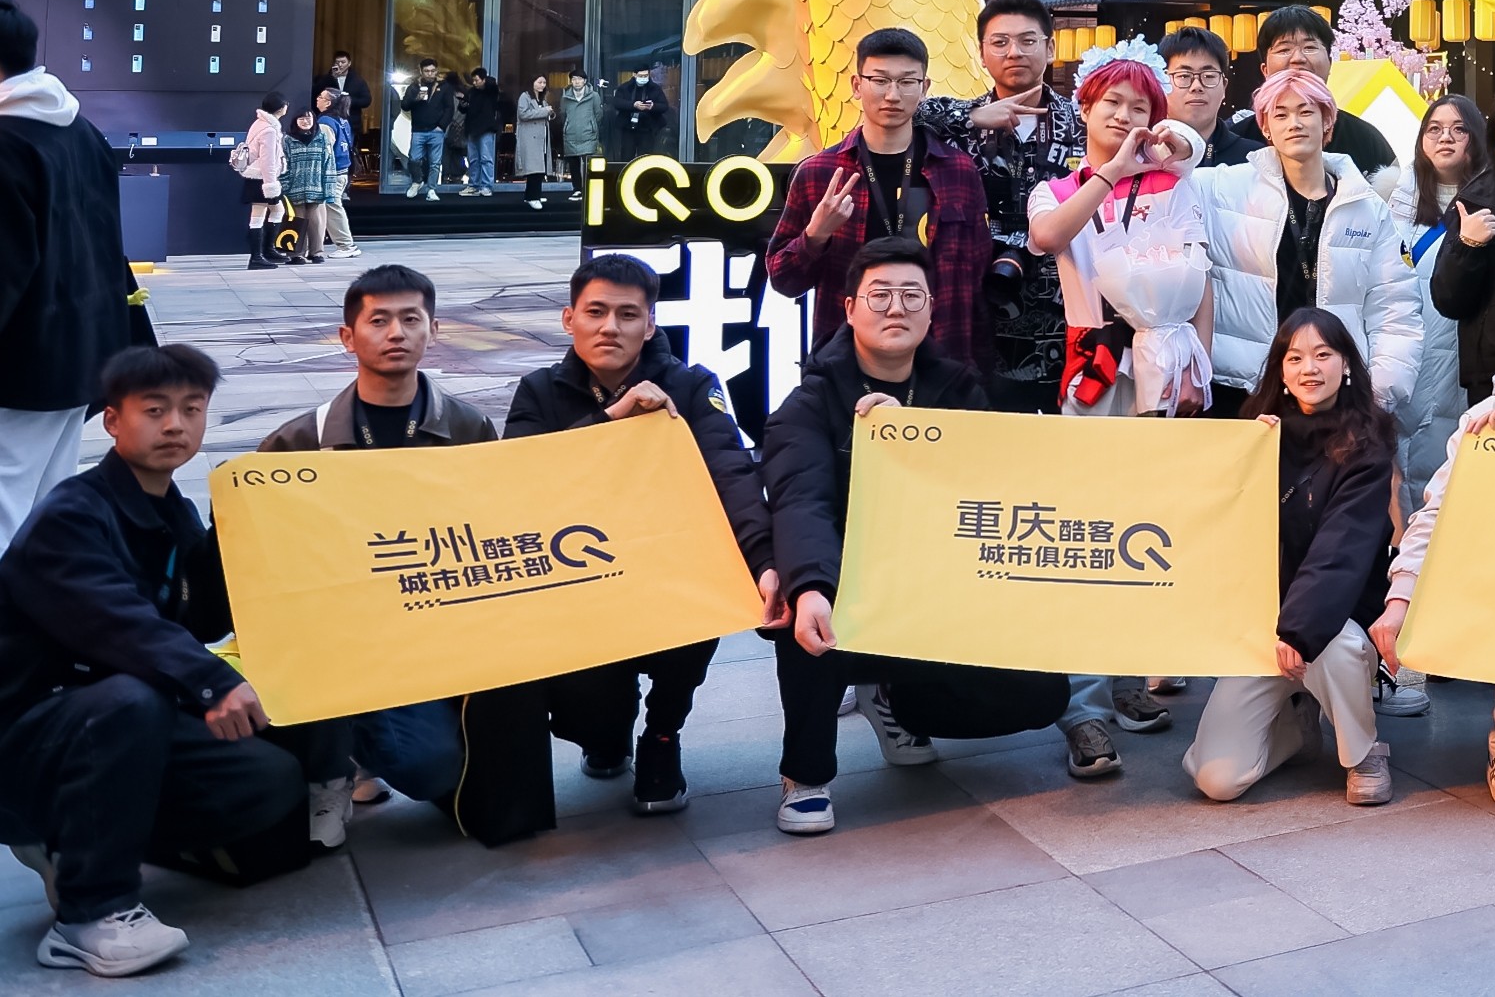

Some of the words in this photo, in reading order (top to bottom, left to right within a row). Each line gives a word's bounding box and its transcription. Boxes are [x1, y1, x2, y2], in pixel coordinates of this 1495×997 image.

[1047, 142, 1068, 168] ET
[587, 154, 774, 226] iQO
[1345, 227, 1372, 239] Bipolar
[869, 423, 943, 443] iQOO
[231, 467, 318, 489] iQOO
[977, 541, 1116, 571] 城市俱乐部
[397, 554, 554, 597] 城市俱乐部
